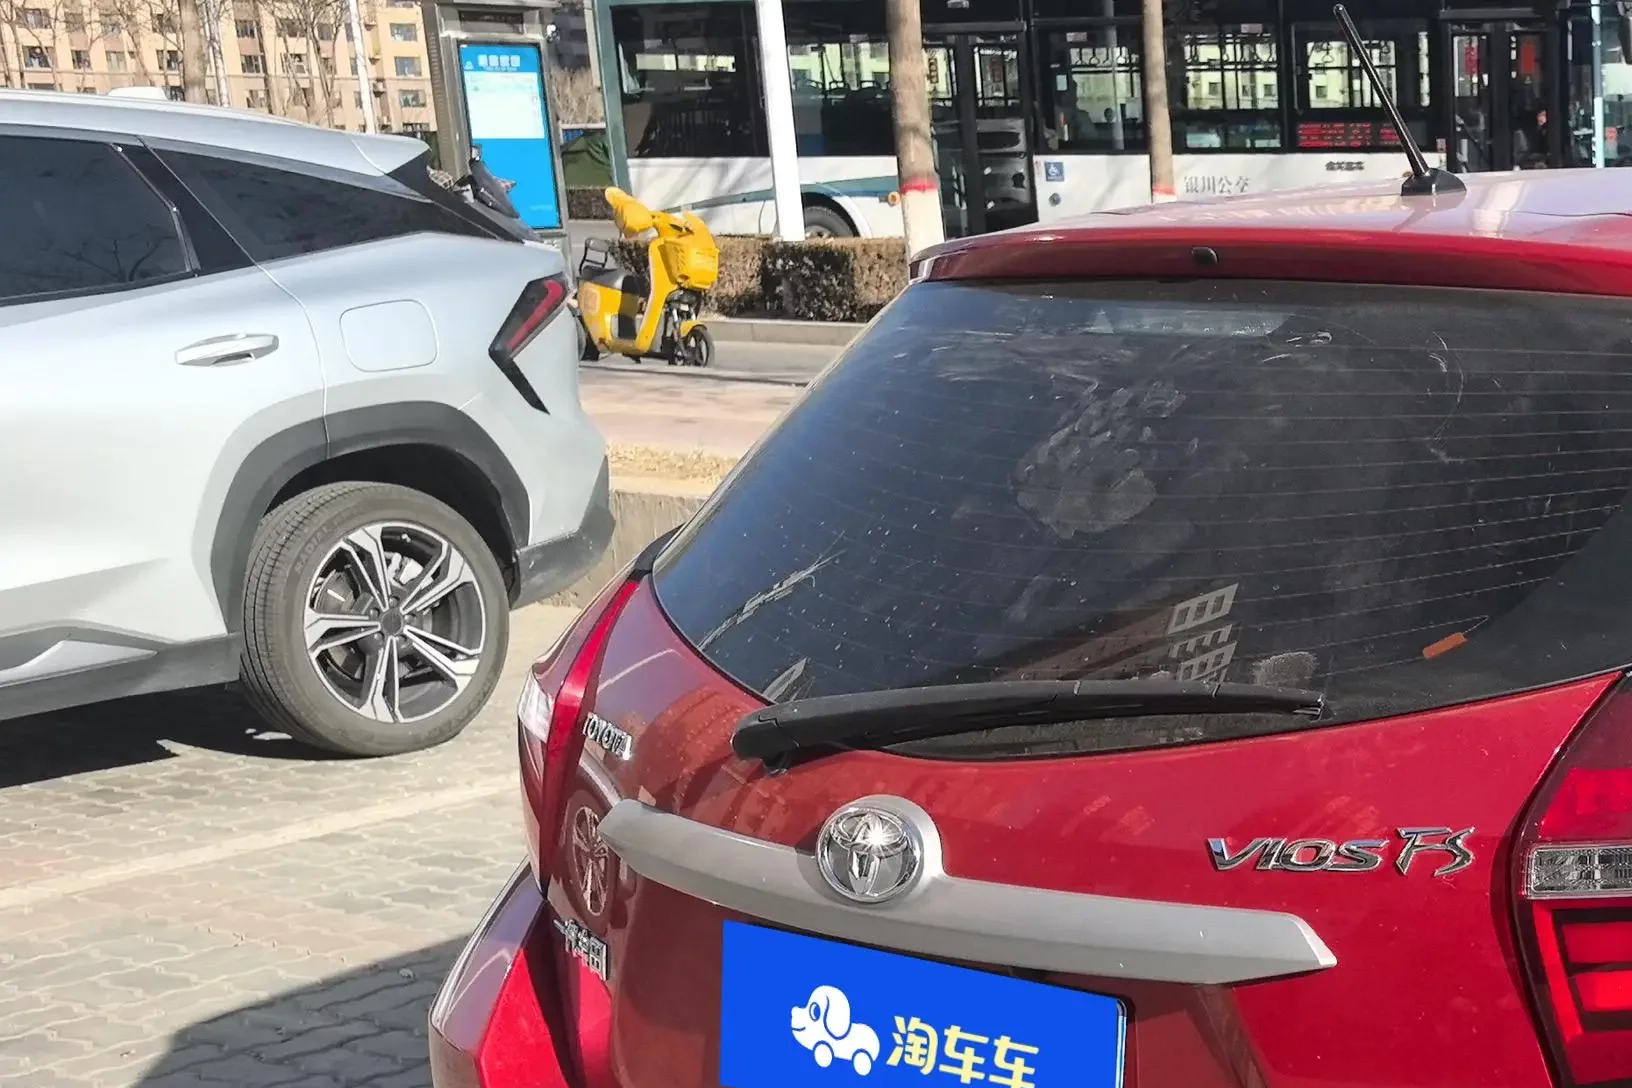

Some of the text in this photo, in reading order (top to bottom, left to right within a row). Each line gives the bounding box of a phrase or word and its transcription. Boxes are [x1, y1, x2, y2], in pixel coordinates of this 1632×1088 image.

[1184, 175, 1250, 195] 银川公交
[583, 711, 632, 761] TOYOTA
[1206, 826, 1475, 876] VIOS FS
